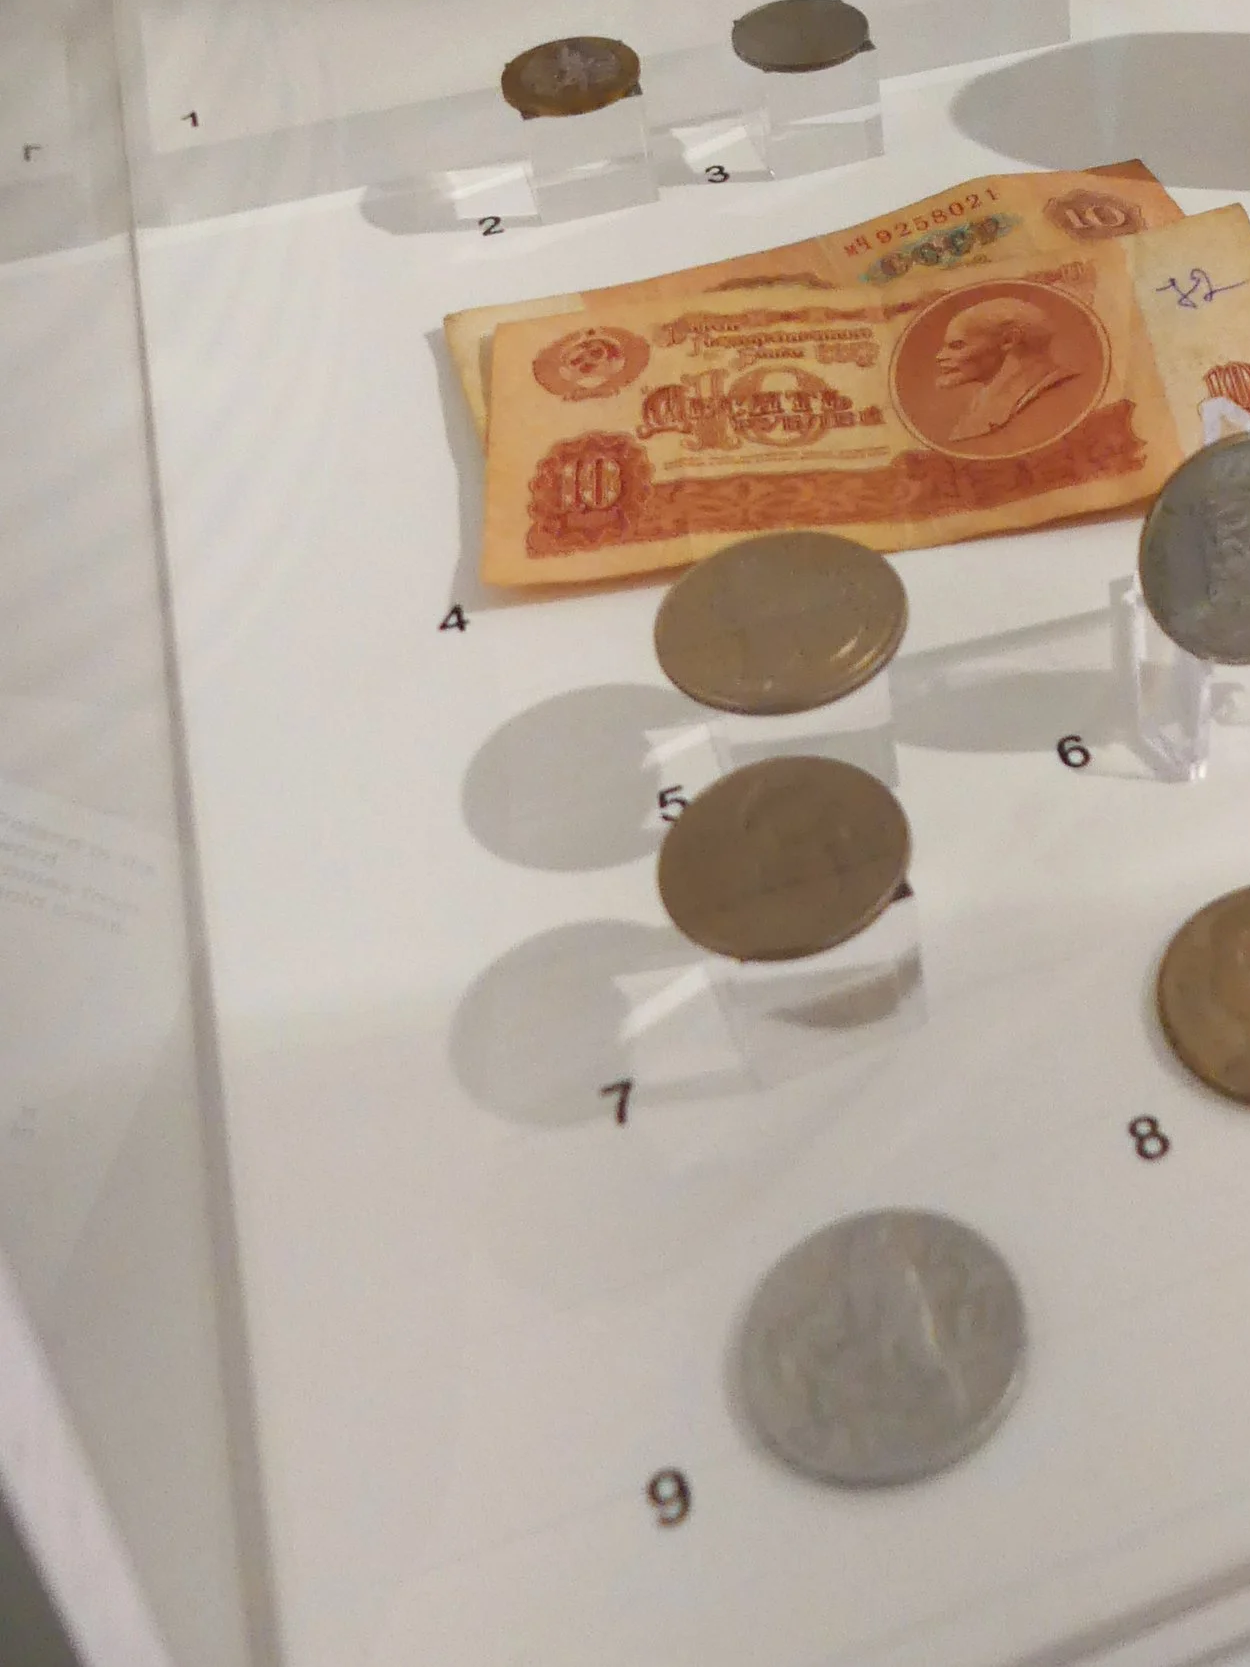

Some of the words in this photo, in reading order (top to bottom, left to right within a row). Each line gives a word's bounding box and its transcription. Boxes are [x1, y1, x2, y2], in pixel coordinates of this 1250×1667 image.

[181, 112, 200, 128] 1
[705, 166, 729, 183] 3
[478, 216, 504, 237] 2
[876, 188, 1000, 244] 9258021
[1064, 203, 1126, 230] 10
[561, 457, 622, 510] 10
[439, 604, 468, 633] 4
[1056, 733, 1091, 770] 6
[657, 786, 689, 822] 5
[600, 1080, 634, 1125] 7
[1128, 1116, 1171, 1161] 8
[646, 1468, 692, 1527] 9
